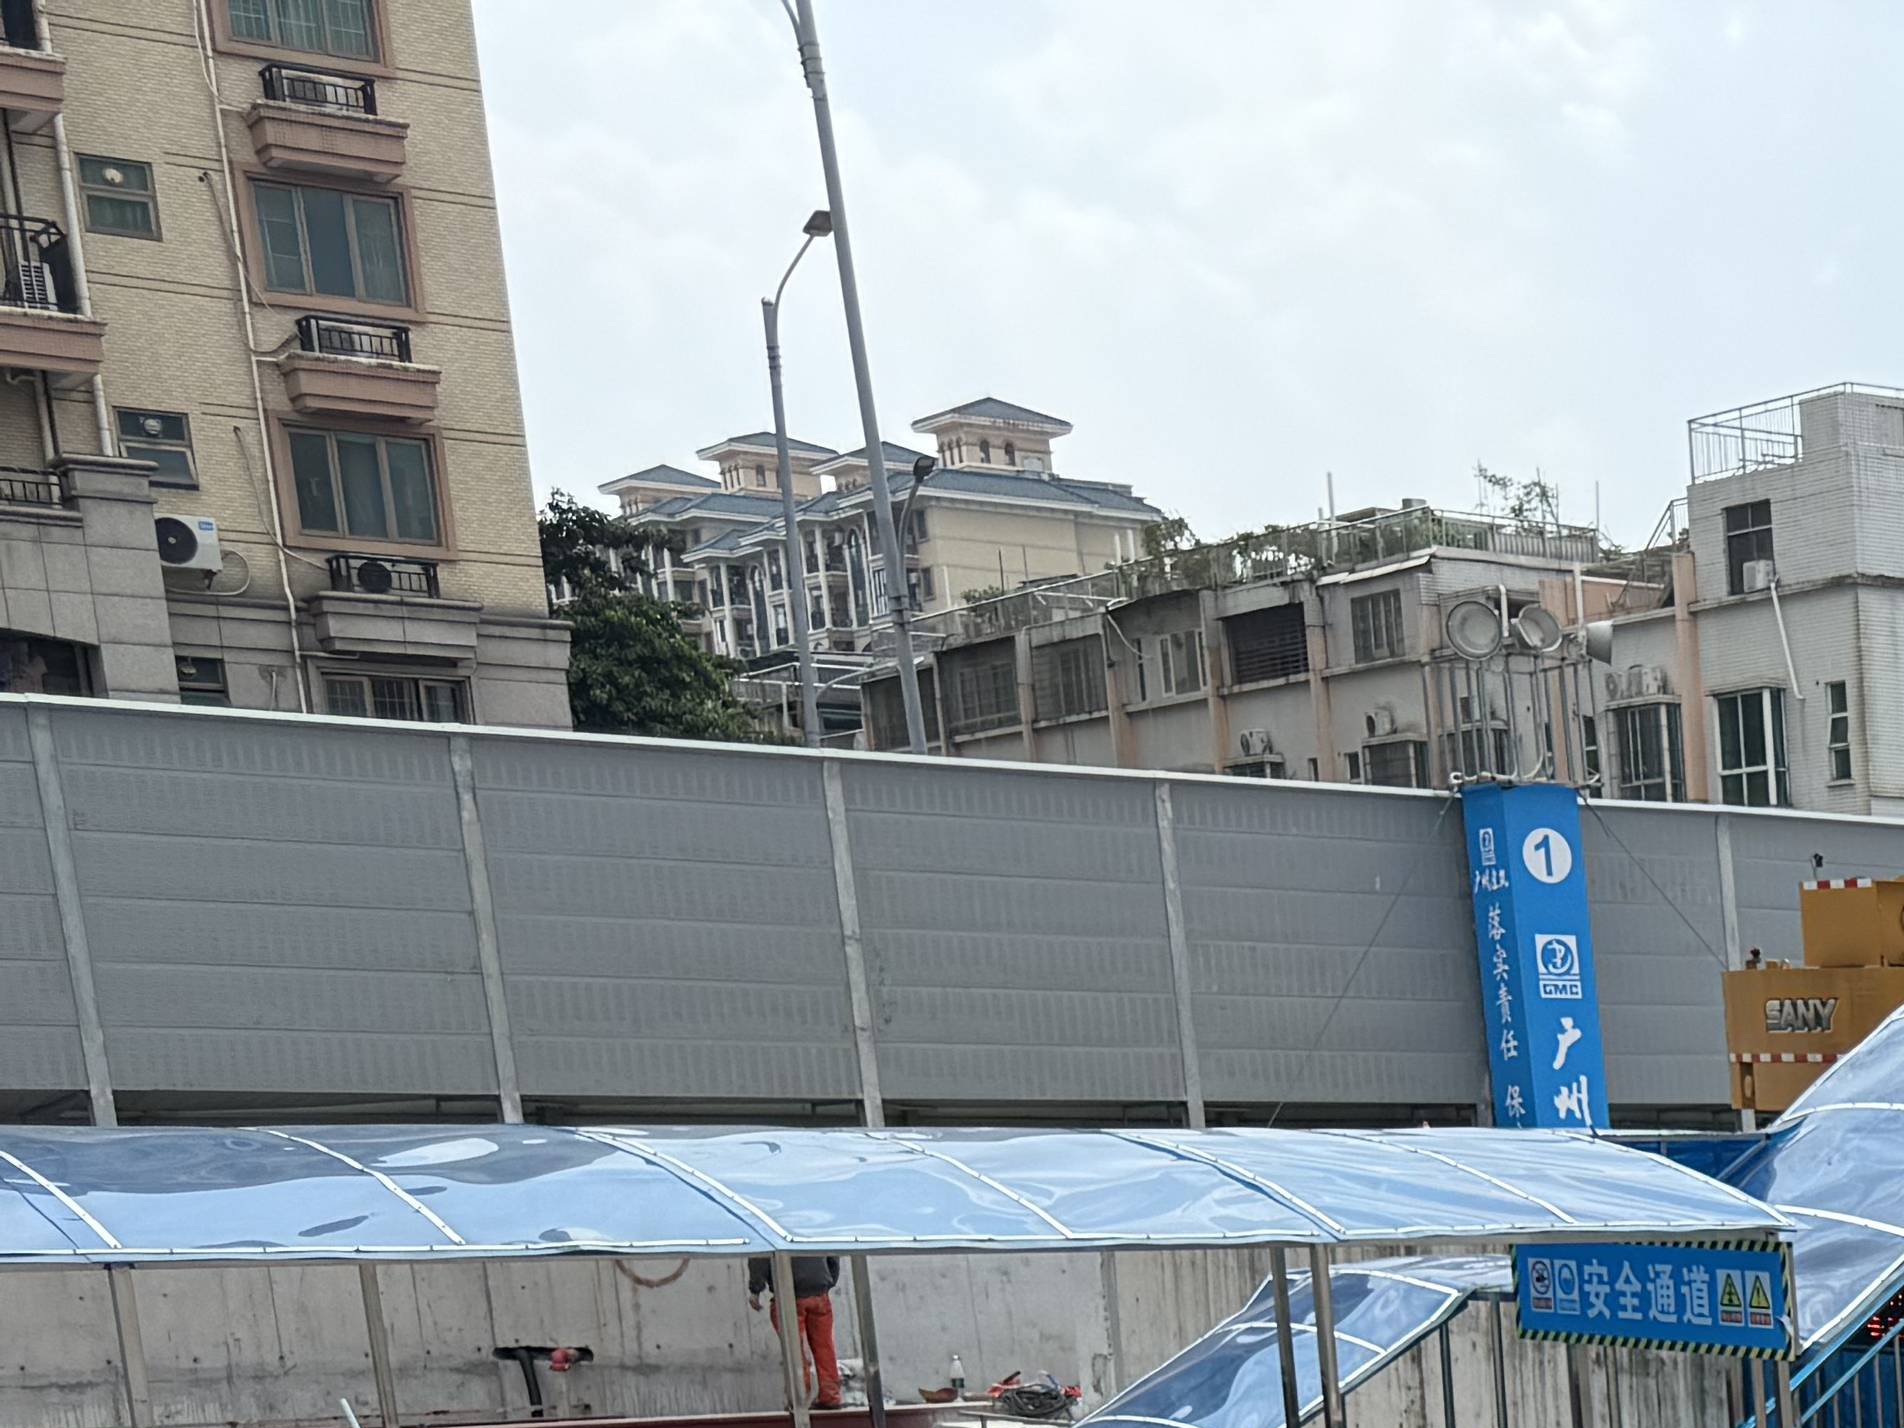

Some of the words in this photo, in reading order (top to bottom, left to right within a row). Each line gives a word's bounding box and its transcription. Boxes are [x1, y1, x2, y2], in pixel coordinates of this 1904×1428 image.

[1533, 834, 1553, 877] 1
[1542, 982, 1581, 997] GMC
[1764, 997, 1839, 1034] SANY
[1582, 1258, 1713, 1326] 安全通道
